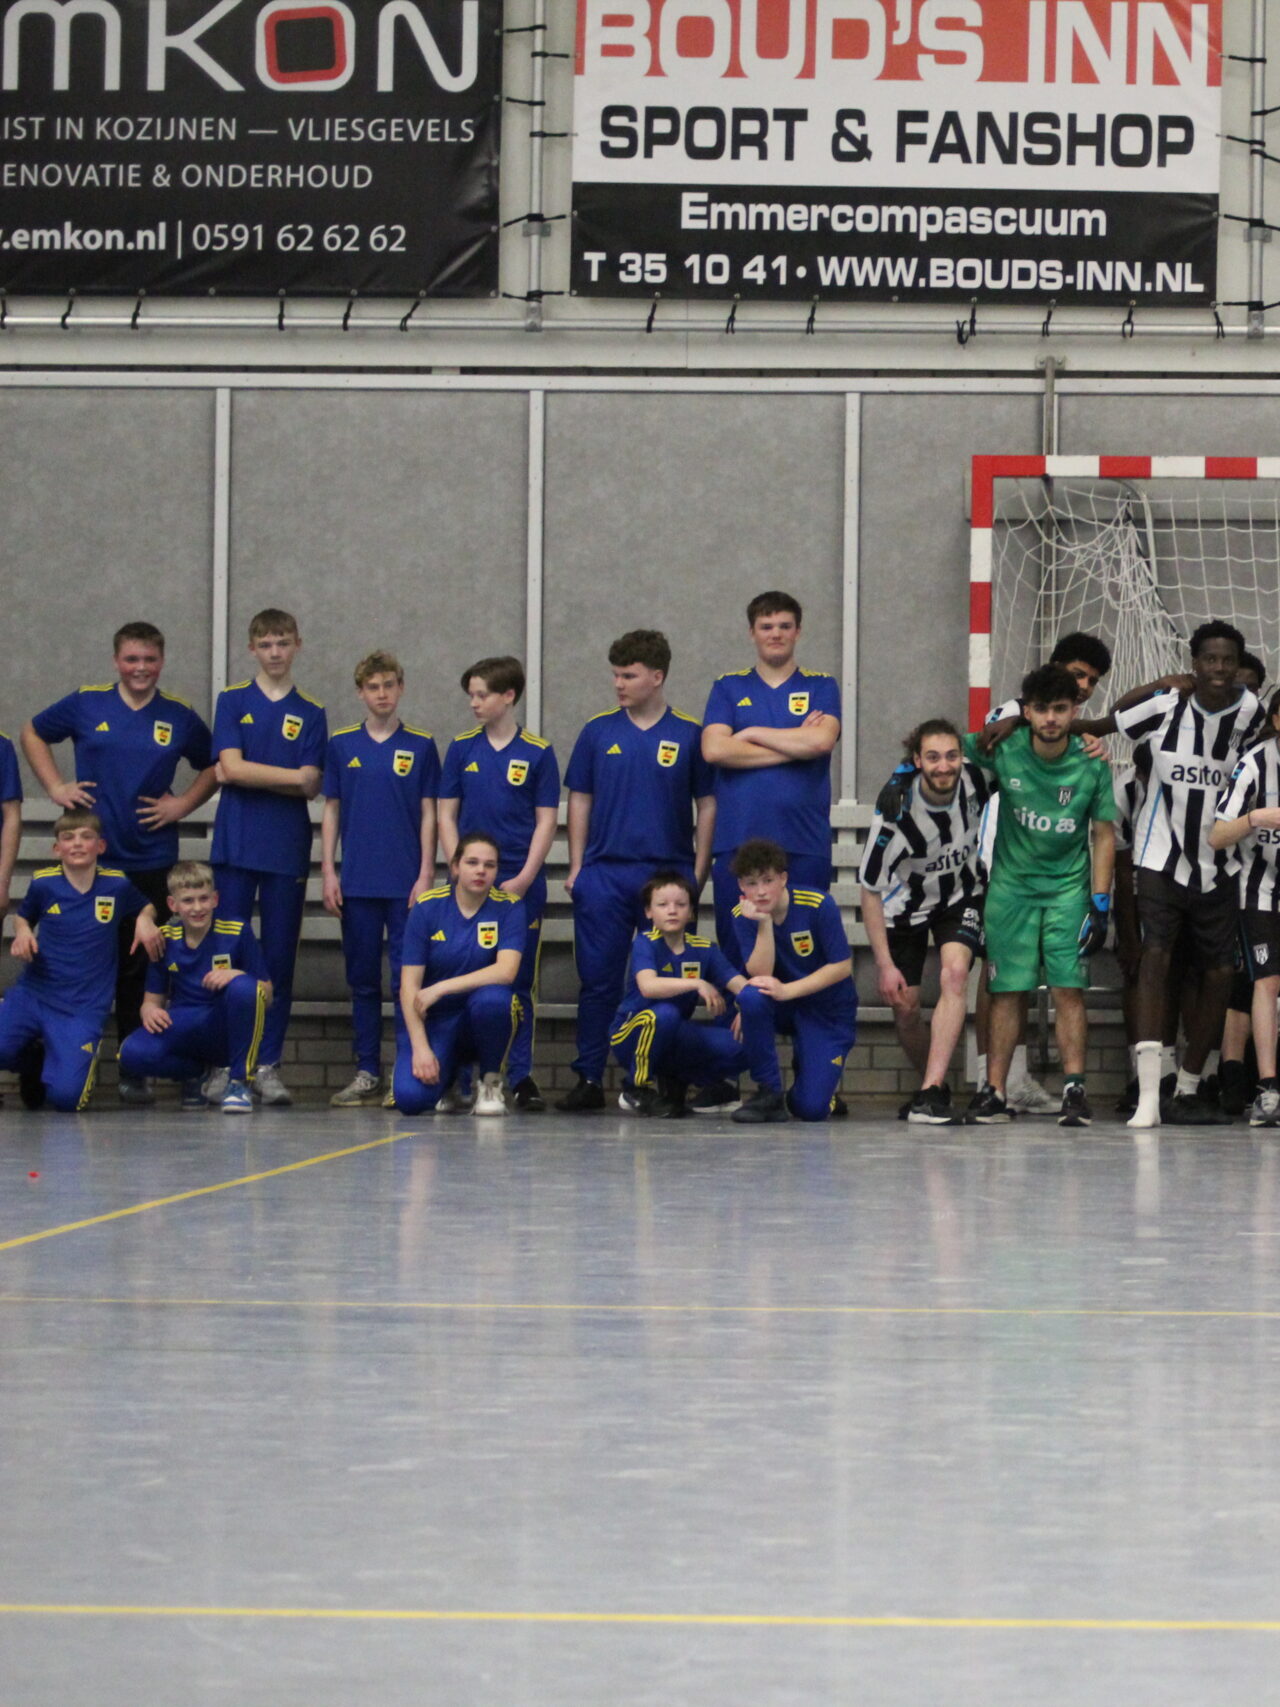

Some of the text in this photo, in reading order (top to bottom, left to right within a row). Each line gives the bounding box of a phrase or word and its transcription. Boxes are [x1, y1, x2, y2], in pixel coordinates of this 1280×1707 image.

[584, 0, 1208, 86] BOUD'S INN
[0, 116, 45, 140] IST
[56, 117, 83, 140] IN
[96, 117, 237, 141] KOZIJNEN
[288, 117, 475, 142] VLIESGEVELS
[600, 105, 1195, 167] SPORT & FANSHOP
[3, 163, 373, 189] ENOVATIE & ONDERHOUD
[681, 192, 1107, 241] Emmercompascuum
[0, 221, 167, 251] .emkon.nl
[192, 223, 263, 251] 0591
[276, 224, 314, 252] 62
[323, 224, 360, 252] 62
[369, 224, 406, 252] 62
[583, 252, 606, 282] T
[619, 252, 667, 284] 35
[685, 253, 730, 284] 10
[742, 254, 788, 285] 41
[817, 255, 1205, 293] WWW.BOUDS-INN.NL
[1170, 764, 1222, 786] asito
[1014, 807, 1051, 831] ito
[925, 845, 970, 872] asito
